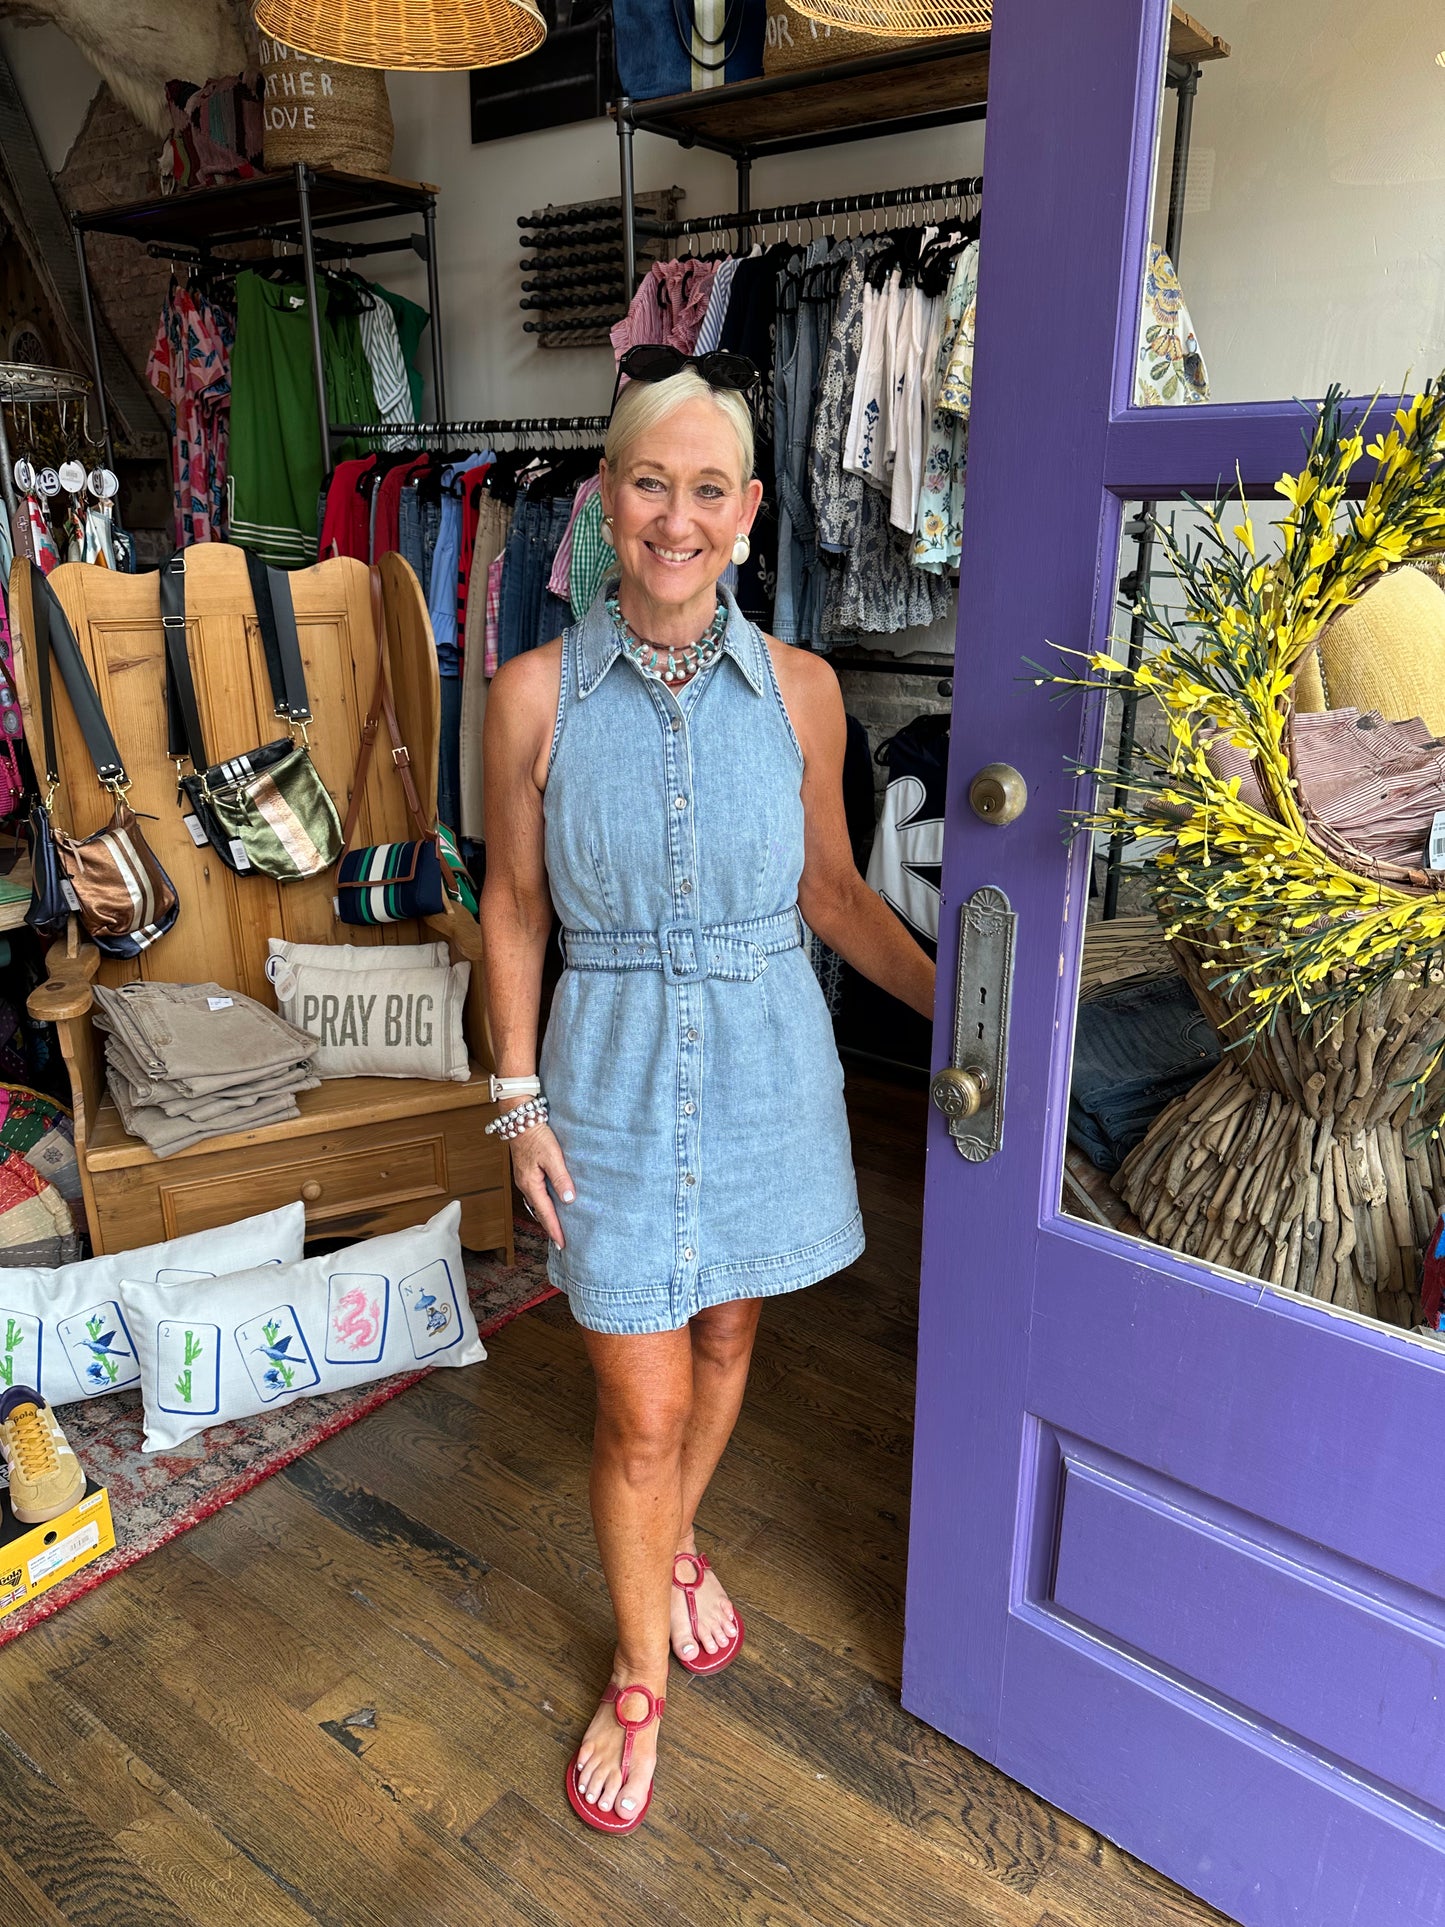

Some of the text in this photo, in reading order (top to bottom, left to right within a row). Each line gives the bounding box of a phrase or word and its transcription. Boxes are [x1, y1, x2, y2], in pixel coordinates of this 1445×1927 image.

[263, 107, 315, 130] LOVE
[303, 994, 433, 1047] PRAY BIG
[163, 1327, 170, 1338] 2
